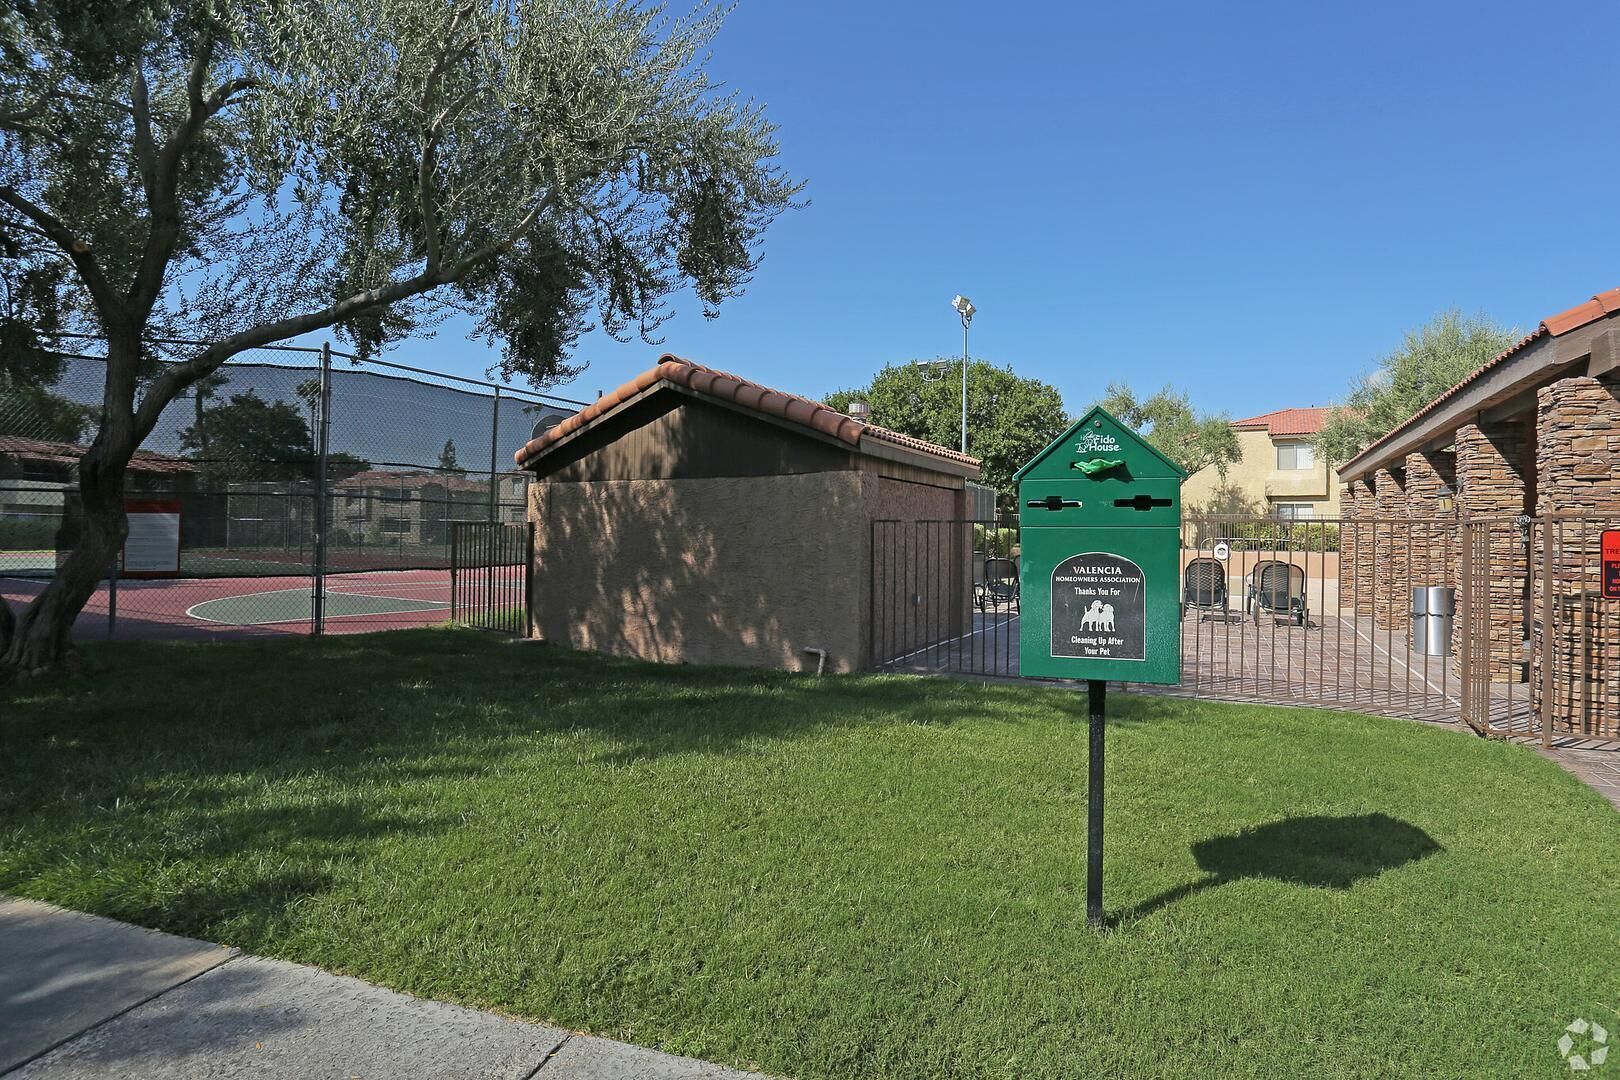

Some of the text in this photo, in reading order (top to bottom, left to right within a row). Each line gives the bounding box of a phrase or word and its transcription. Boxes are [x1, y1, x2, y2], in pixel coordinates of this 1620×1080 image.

[1093, 434, 1116, 444] Fido
[1089, 444, 1120, 452] House
[1073, 566, 1122, 575] VALENCIA
[1074, 587, 1121, 596] Thanks You For
[1071, 635, 1124, 646] Cleaning Up After
[1084, 647, 1111, 656] Your Pet
